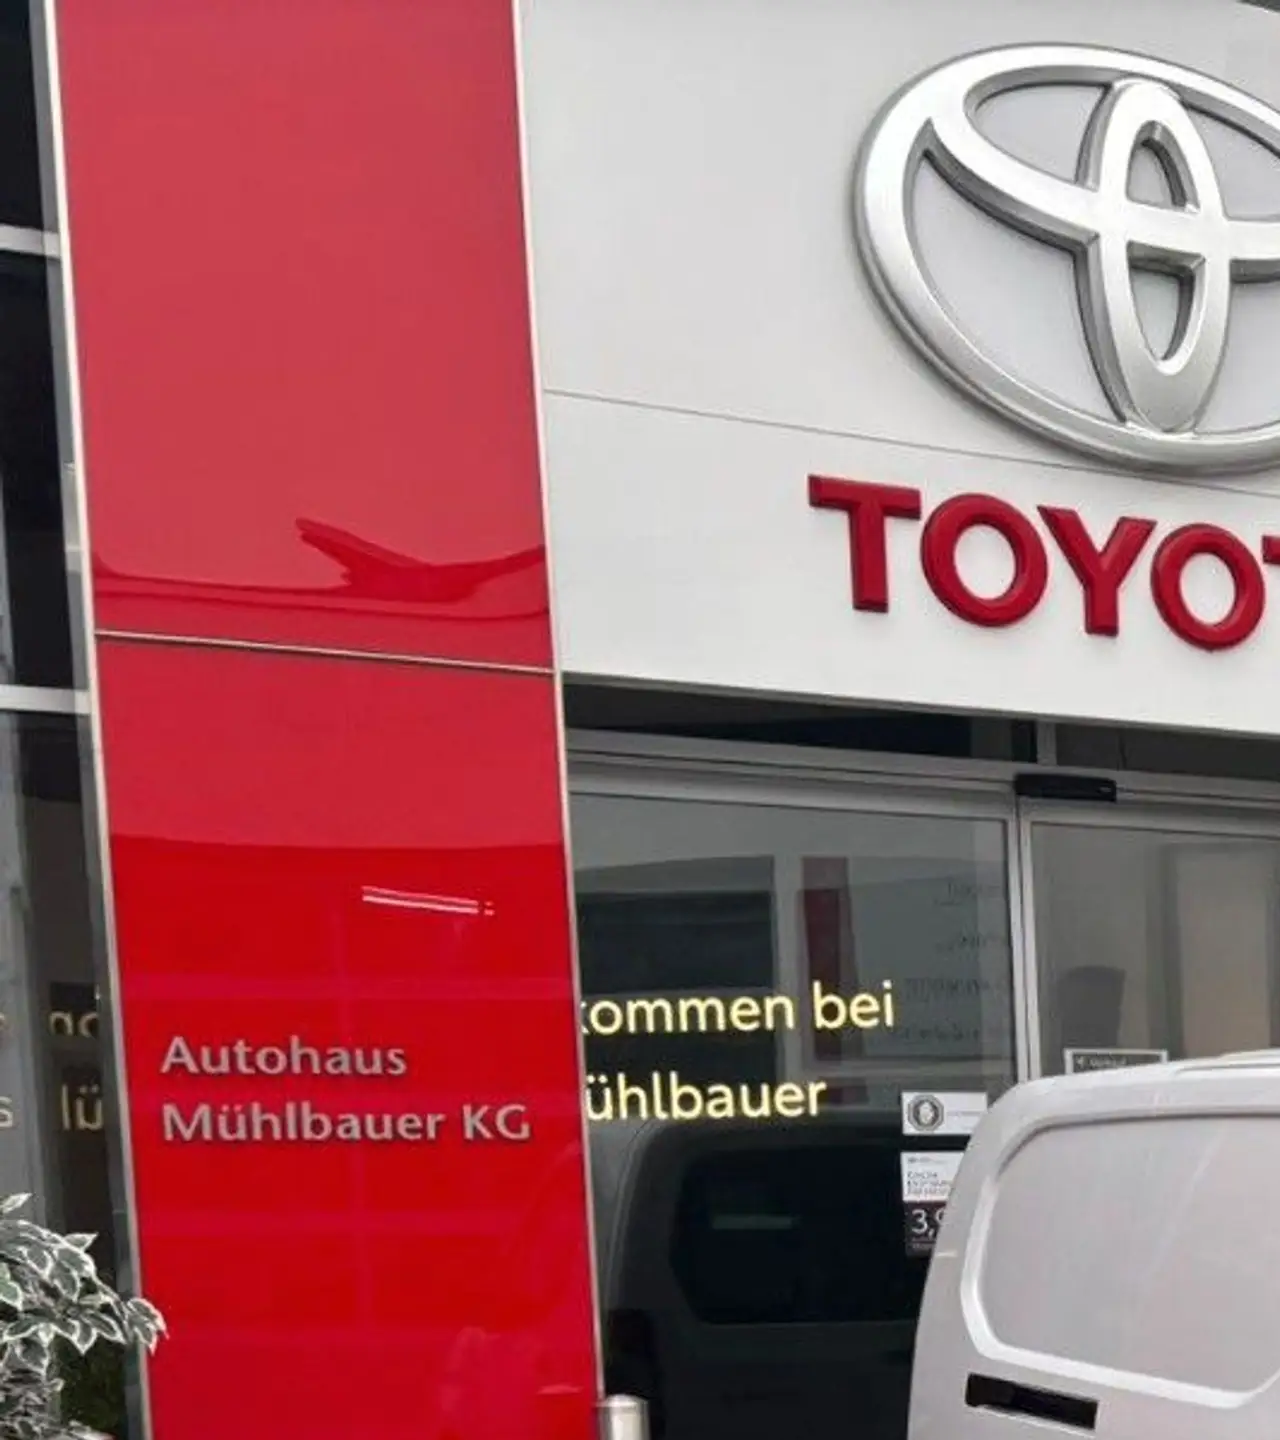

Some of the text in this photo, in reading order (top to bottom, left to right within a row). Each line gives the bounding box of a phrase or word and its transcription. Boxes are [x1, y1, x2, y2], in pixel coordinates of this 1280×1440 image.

[811, 979, 896, 1031] bei
[159, 1035, 408, 1076] Autohaus
[162, 1099, 533, 1142] Mühlbauer KG
